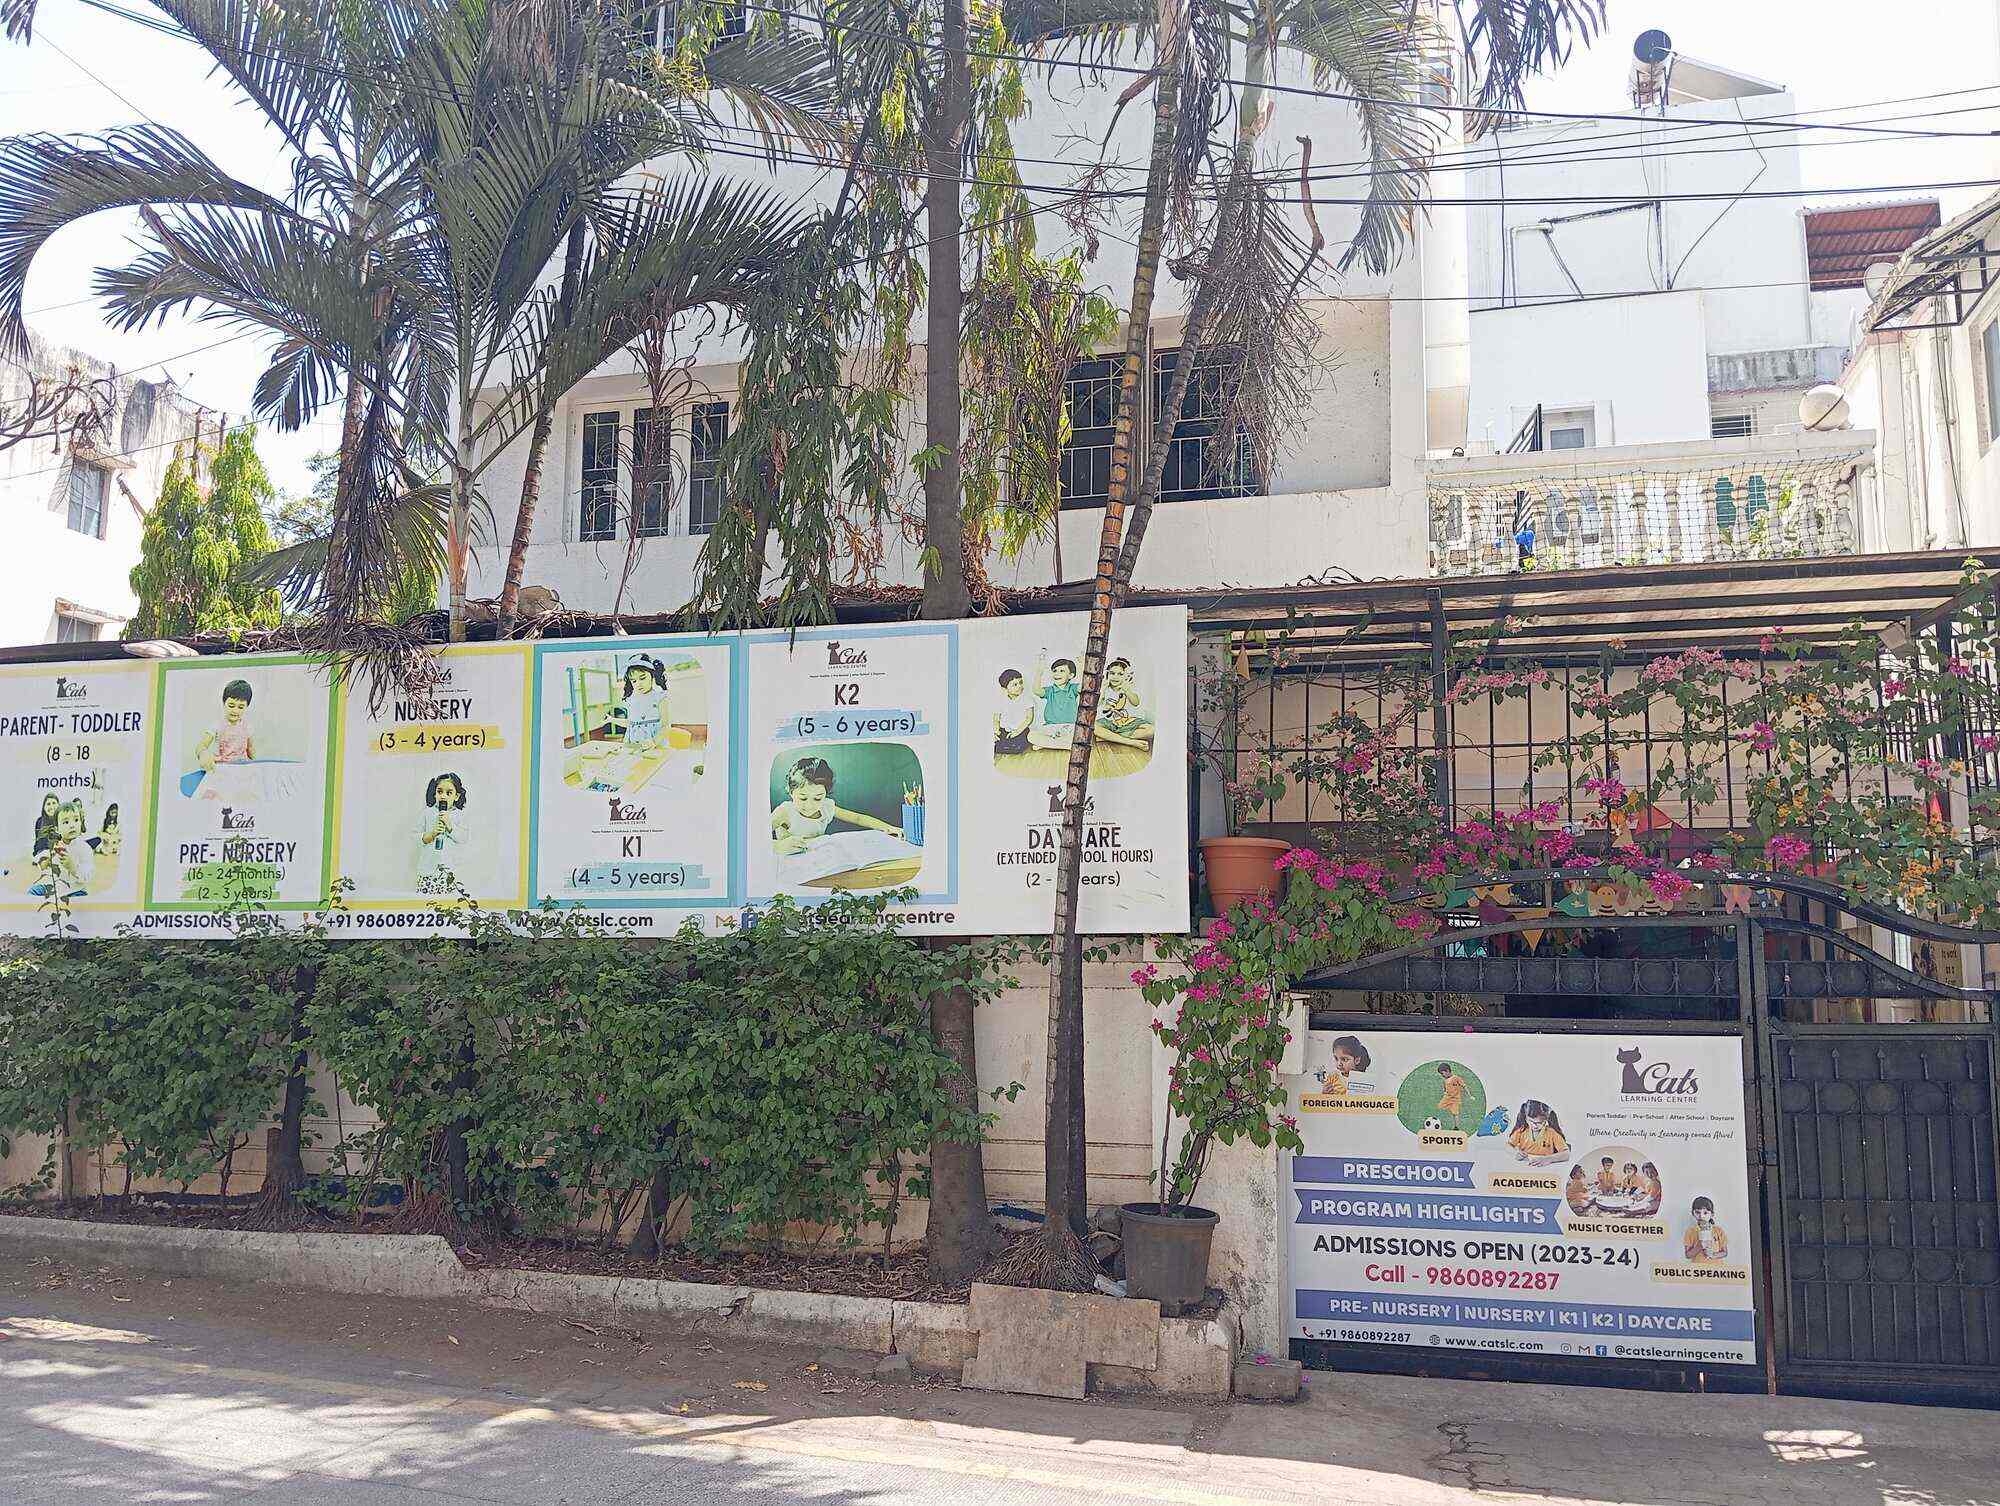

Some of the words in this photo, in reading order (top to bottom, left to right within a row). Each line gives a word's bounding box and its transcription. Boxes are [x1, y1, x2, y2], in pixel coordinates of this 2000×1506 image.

[839, 648, 867, 664] Cats
[64, 683, 87, 698] Cats
[835, 684, 860, 706] K2
[395, 698, 473, 721] NUSERY
[0, 715, 64, 736] PARENT-
[72, 712, 142, 733] TODDLER
[797, 717, 815, 737] (5
[837, 716, 848, 733] 6
[854, 712, 916, 736] years)
[379, 732, 395, 751] (3
[415, 731, 426, 747] 4
[432, 729, 486, 751] years)
[47, 745, 60, 764] (8
[76, 745, 90, 760] 18
[37, 771, 96, 789] months)
[230, 813, 255, 829] Cats
[620, 805, 647, 821] Cats
[622, 835, 642, 857] K1
[1028, 826, 1121, 849] DAARE
[180, 844, 216, 863] PRE-
[222, 841, 297, 864] NURSERY
[997, 851, 1057, 865] (EXTENDED
[1111, 849, 1153, 864] HOURS)
[187, 867, 204, 881] (16
[216, 867, 233, 880] 24
[236, 866, 286, 881] months)
[571, 868, 590, 888] (4
[610, 868, 621, 885] 5
[627, 866, 686, 888] years)
[1026, 872, 1041, 888] (2
[1078, 871, 1121, 887] ears)
[198, 886, 210, 900] (2
[222, 887, 231, 899] 3
[132, 914, 232, 928] ADMISSIONS
[327, 913, 351, 928] +91
[516, 912, 654, 928] wwwaslc.com
[1639, 1062, 1699, 1095] Cats
[1302, 1099, 1343, 1108] FOREIGN
[1344, 1101, 1395, 1109] LANGUAGE
[1620, 1095, 1663, 1104] LEARNING
[1666, 1096, 1697, 1104] CENTRE
[1422, 1135, 1464, 1146] SPORTS
[1343, 1162, 1465, 1183] PRESCHOOL
[1492, 1177, 1558, 1190] ACADEMICS
[1311, 1199, 1412, 1220] PROGRAM
[1417, 1203, 1547, 1225] HIGHLIGHTS
[1567, 1222, 1603, 1234] MUSIC
[1604, 1224, 1665, 1236] TOGETHER
[1313, 1234, 1458, 1259] ADMISSIONS
[1463, 1241, 1525, 1262] OPEN
[1531, 1243, 1641, 1270] (2023-24)
[1364, 1263, 1405, 1284] Call
[1426, 1267, 1561, 1291] 9860892287
[1654, 1267, 1692, 1279] PUBLIC
[1692, 1268, 1747, 1280] SPEAKING
[1330, 1299, 1369, 1313] PRE-
[1372, 1300, 1451, 1319] NURSERY
[1463, 1306, 1546, 1325] NURSERY
[1558, 1311, 1579, 1326] K1
[1592, 1312, 1615, 1328] K2
[1628, 1314, 1713, 1332] DAYCARE
[1319, 1329, 1337, 1339] +91
[1340, 1330, 1412, 1343] 9860892287
[1445, 1336, 1544, 1351] www.catslc.com
[1614, 1345, 1745, 1361] @catslearningcentre
